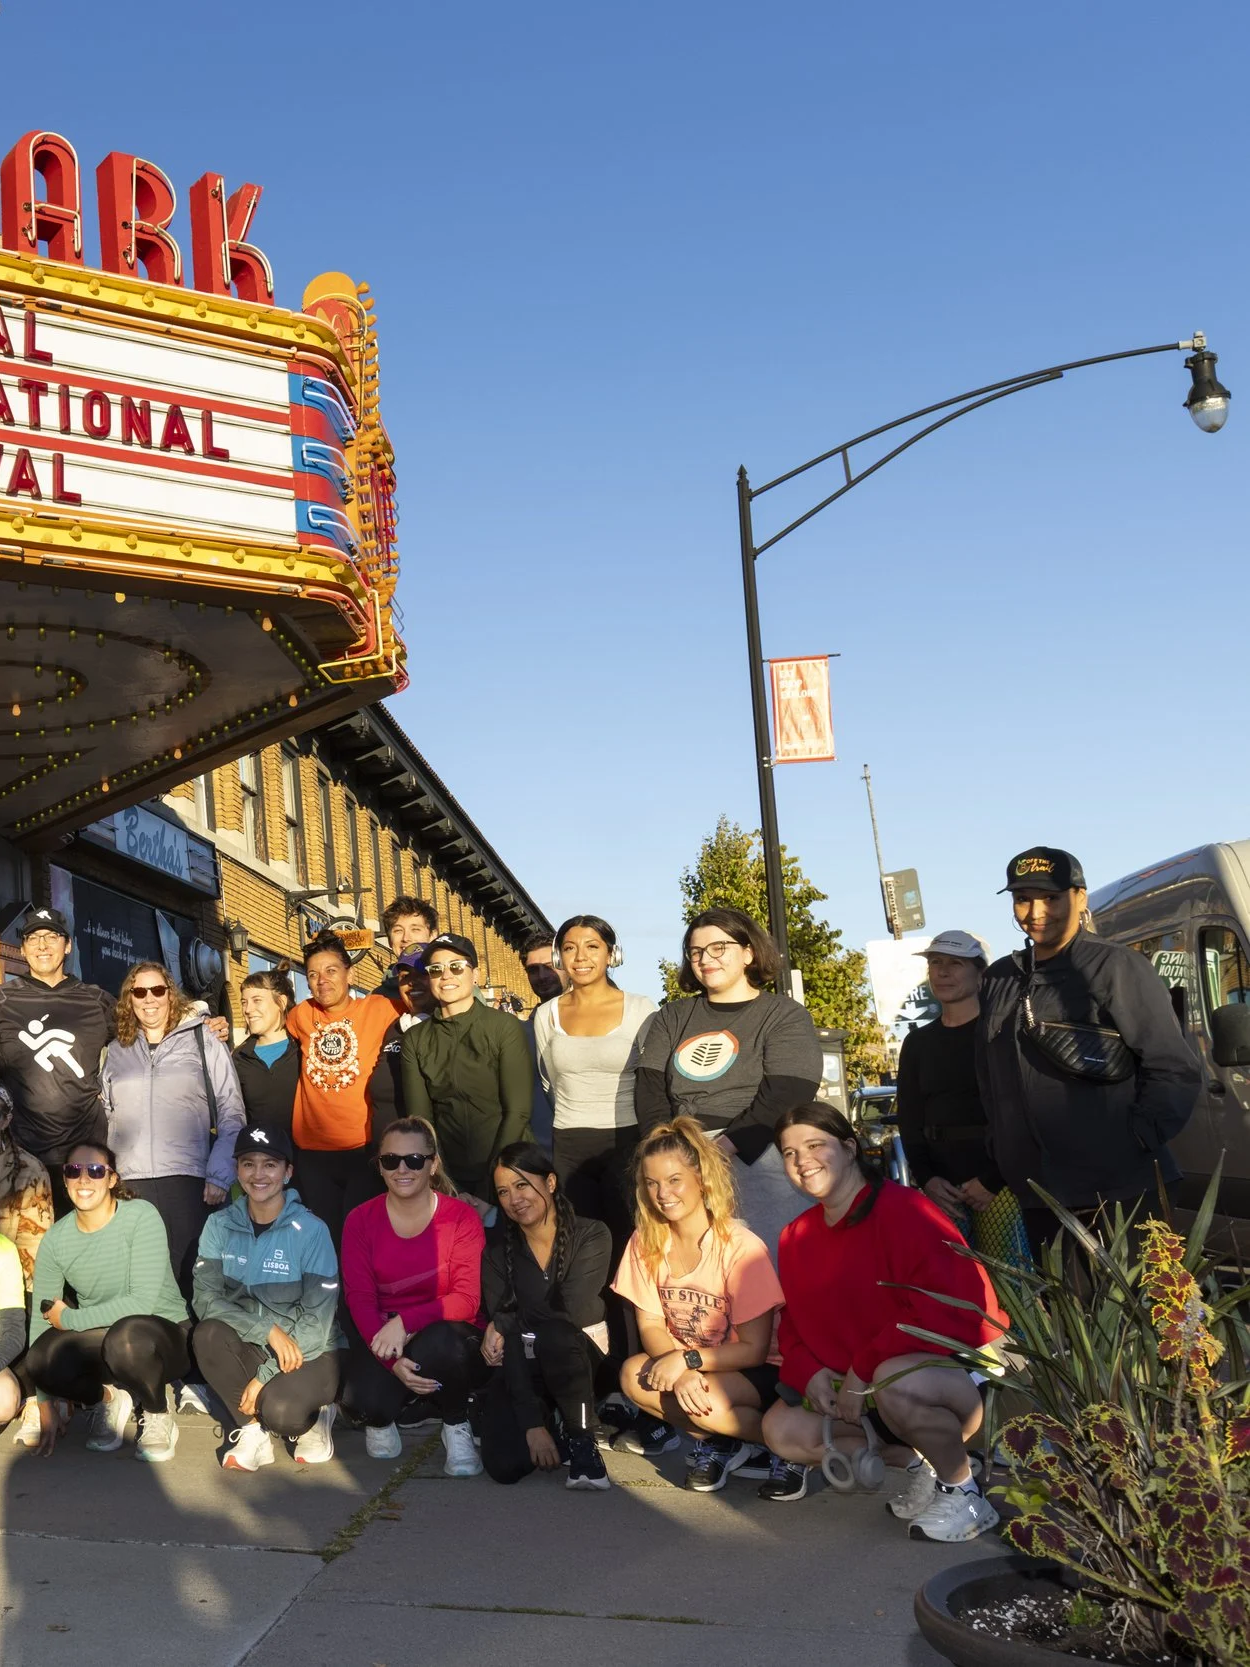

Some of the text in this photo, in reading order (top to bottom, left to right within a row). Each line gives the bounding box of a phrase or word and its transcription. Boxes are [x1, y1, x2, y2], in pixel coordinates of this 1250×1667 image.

[123, 804, 184, 877] Bertha's
[263, 1261, 290, 1271] LISBOA
[678, 1289, 723, 1311] STYLE
